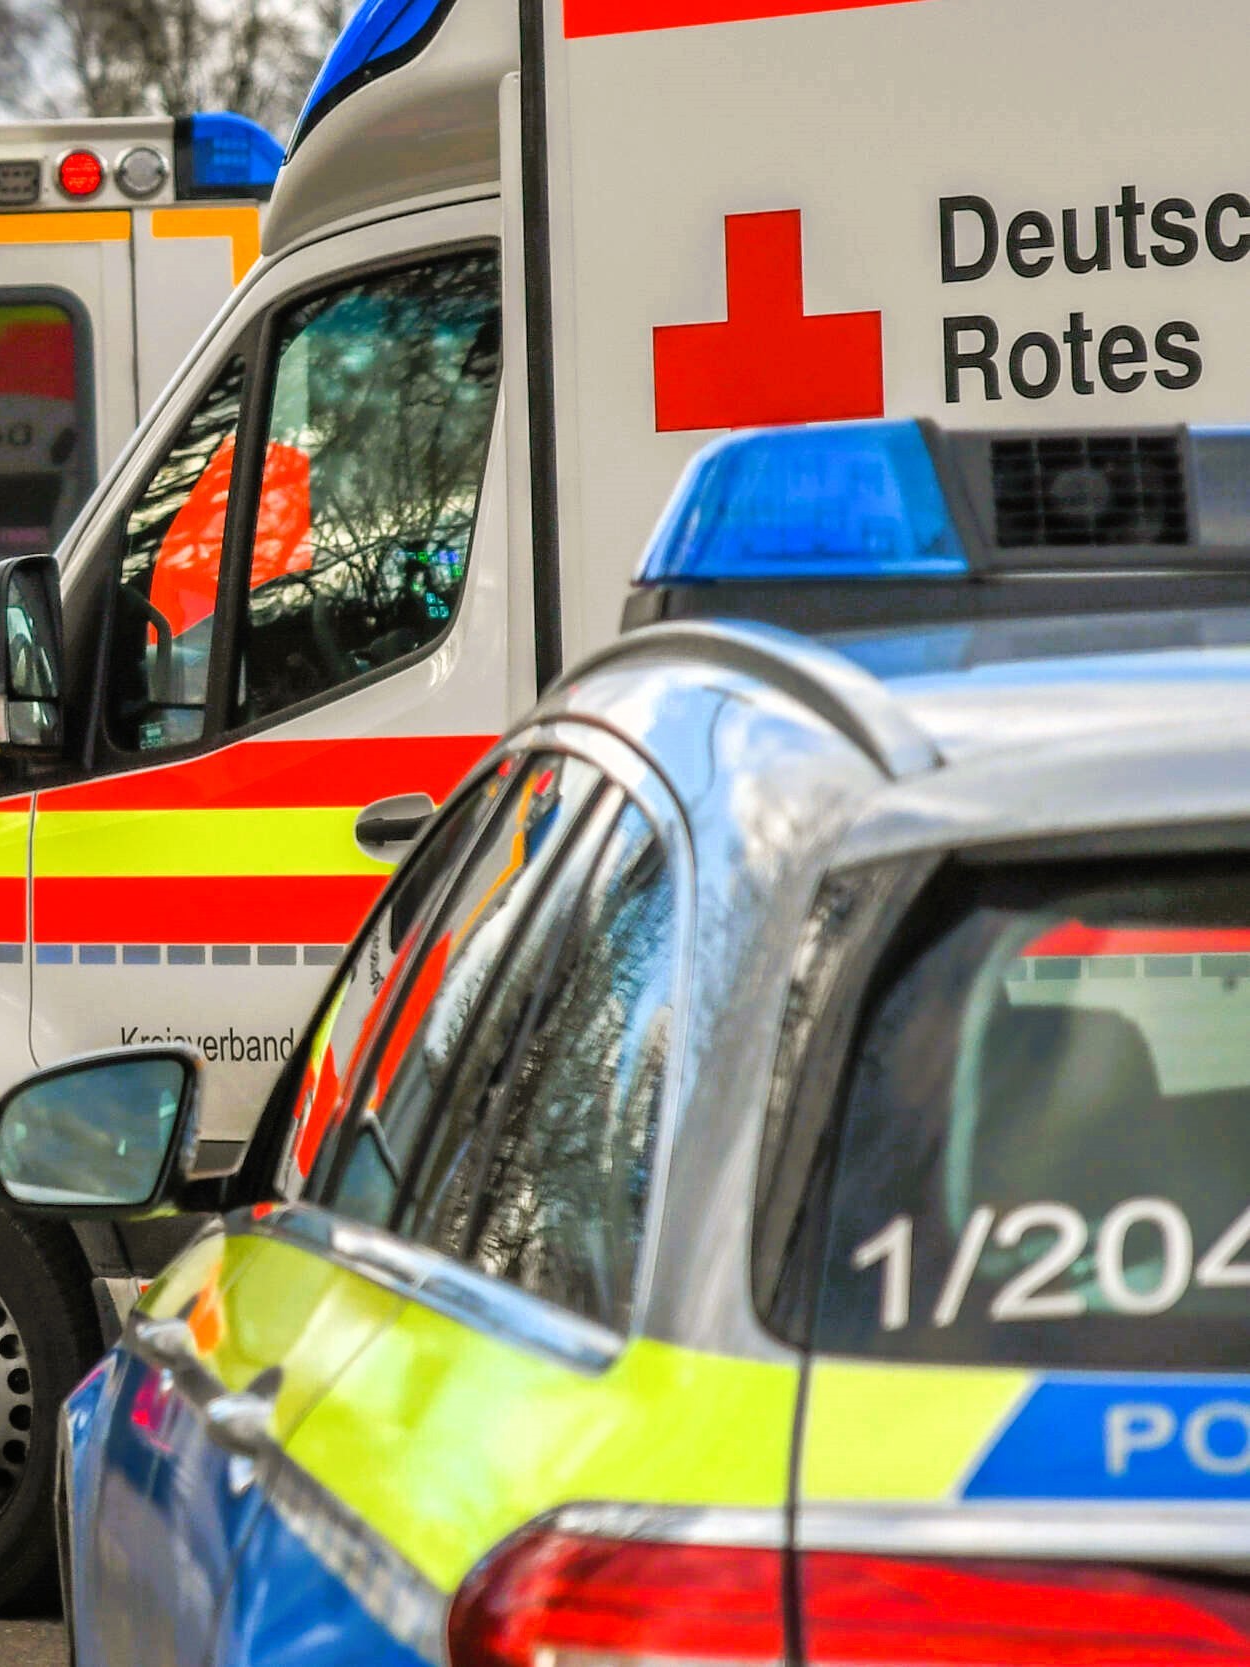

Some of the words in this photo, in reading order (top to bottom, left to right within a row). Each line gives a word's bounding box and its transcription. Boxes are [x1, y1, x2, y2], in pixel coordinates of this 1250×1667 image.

[939, 185, 1250, 283] Deutsc
[943, 312, 1203, 403] Rotes
[1104, 1400, 1250, 1477] PO
